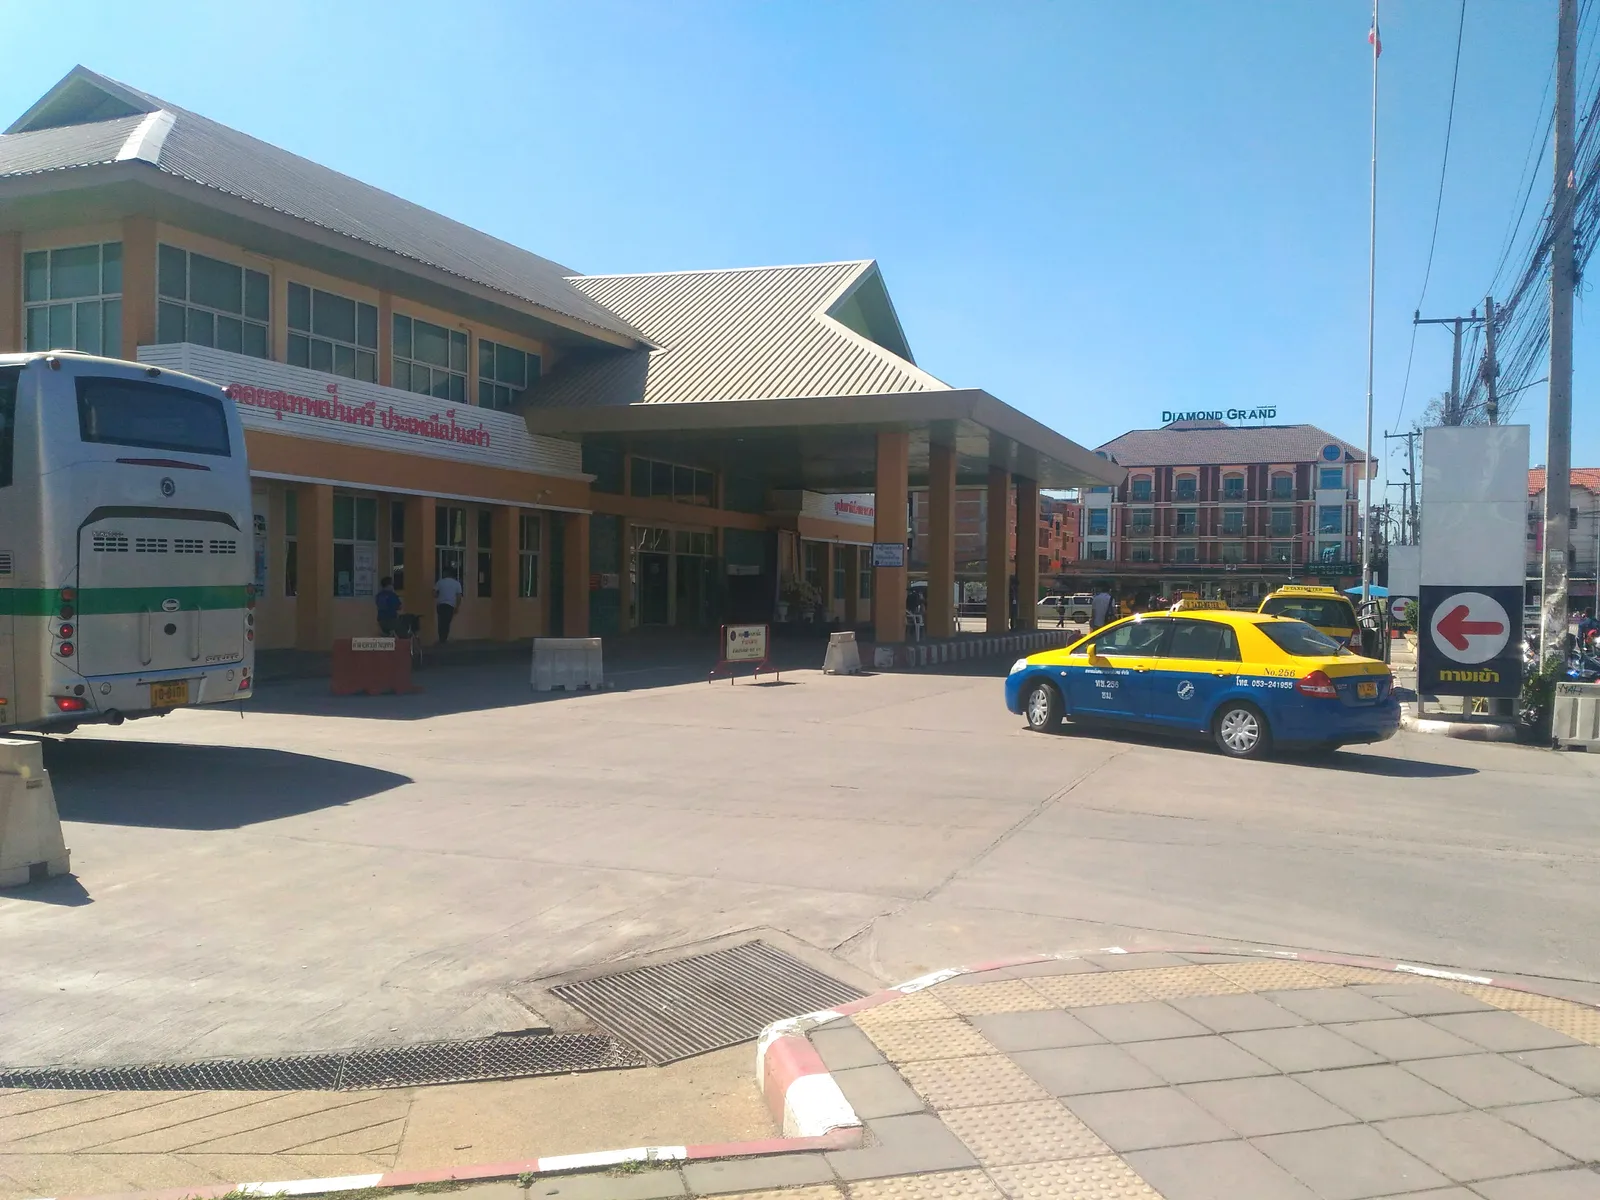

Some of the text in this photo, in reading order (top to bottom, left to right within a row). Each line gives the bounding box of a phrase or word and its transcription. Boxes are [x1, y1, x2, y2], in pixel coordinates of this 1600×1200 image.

[1162, 408, 1277, 423] DIAMOND GRAND
[1439, 667, 1500, 683] ทางเข้า
[1251, 679, 1293, 689] 053-241955
